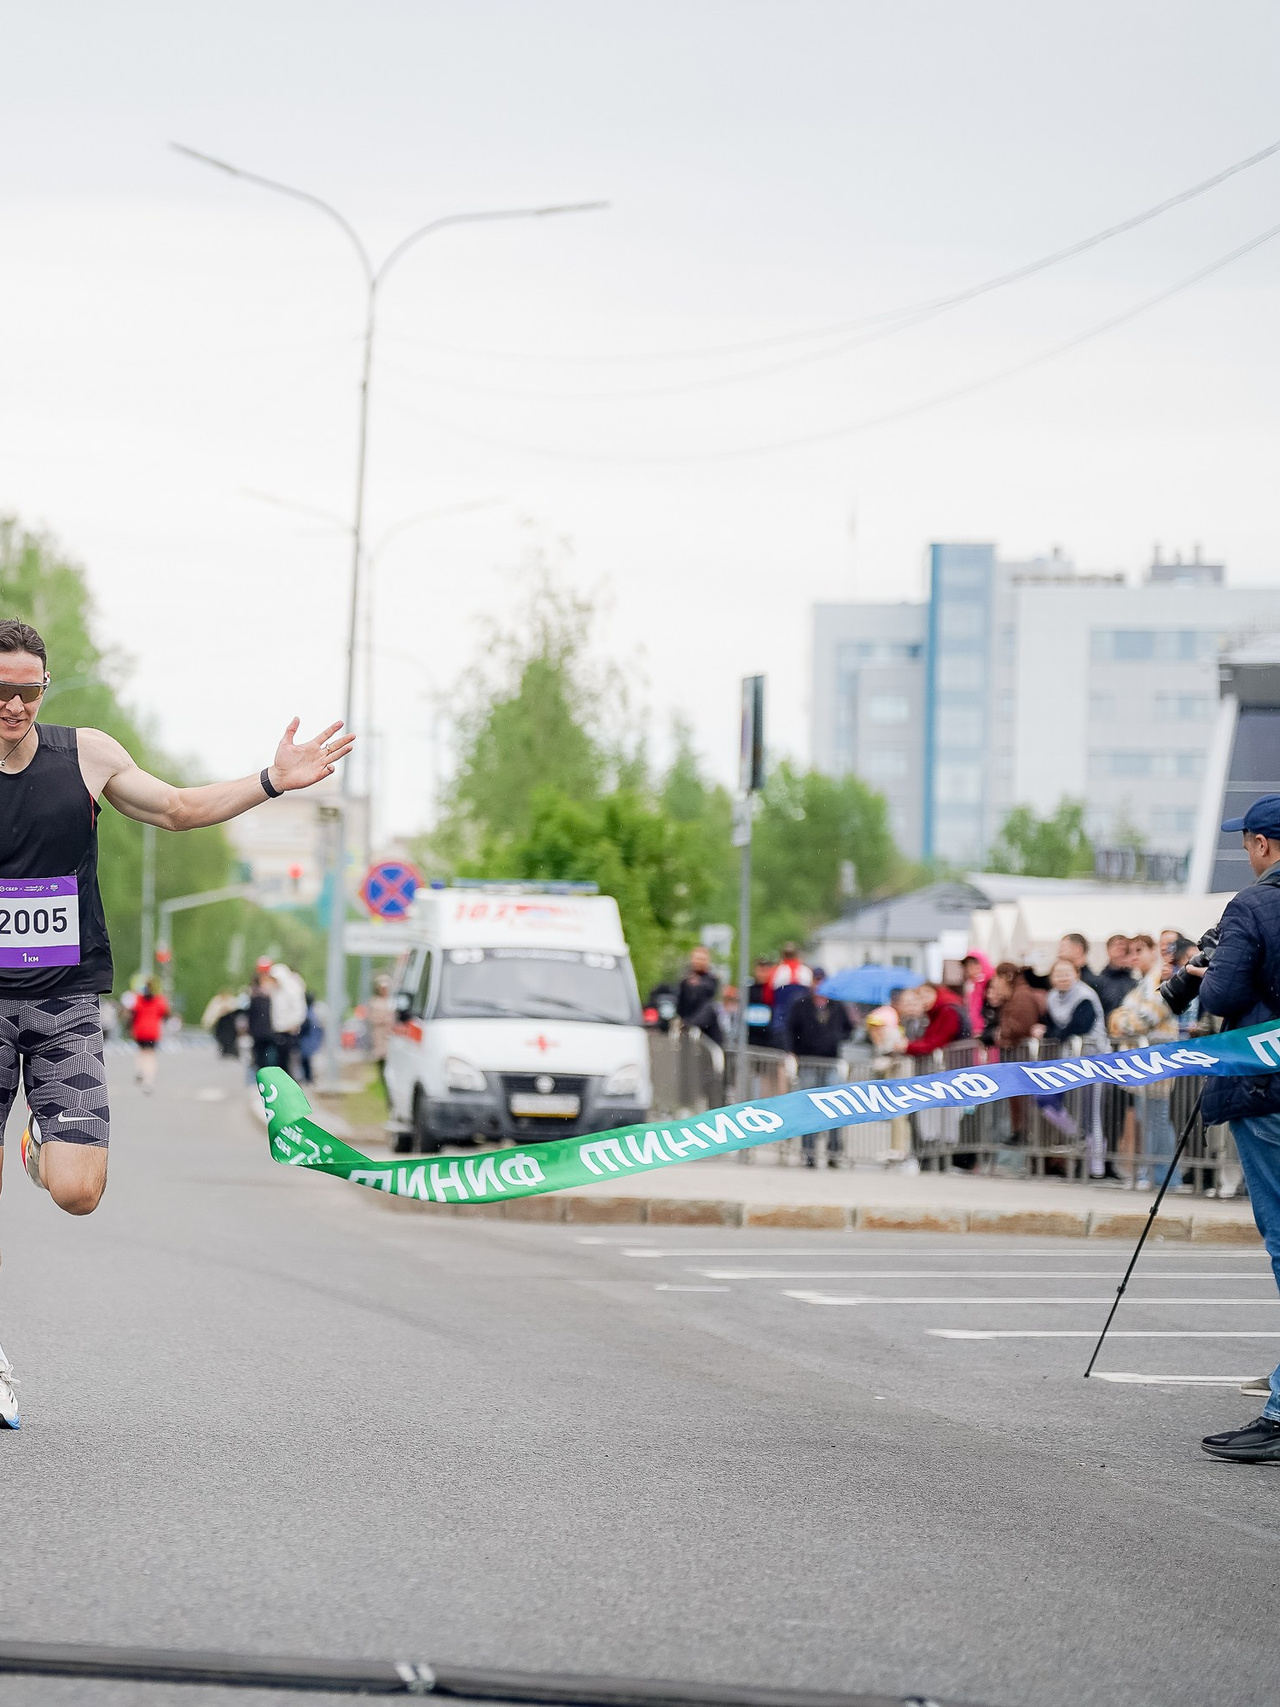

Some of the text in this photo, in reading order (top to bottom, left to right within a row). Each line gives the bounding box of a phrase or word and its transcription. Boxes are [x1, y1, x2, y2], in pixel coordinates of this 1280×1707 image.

[1019, 1049, 1220, 1090] ФИНИШ
[807, 1072, 1000, 1119] ФИНИШ
[579, 1106, 784, 1175] ФИНИШ
